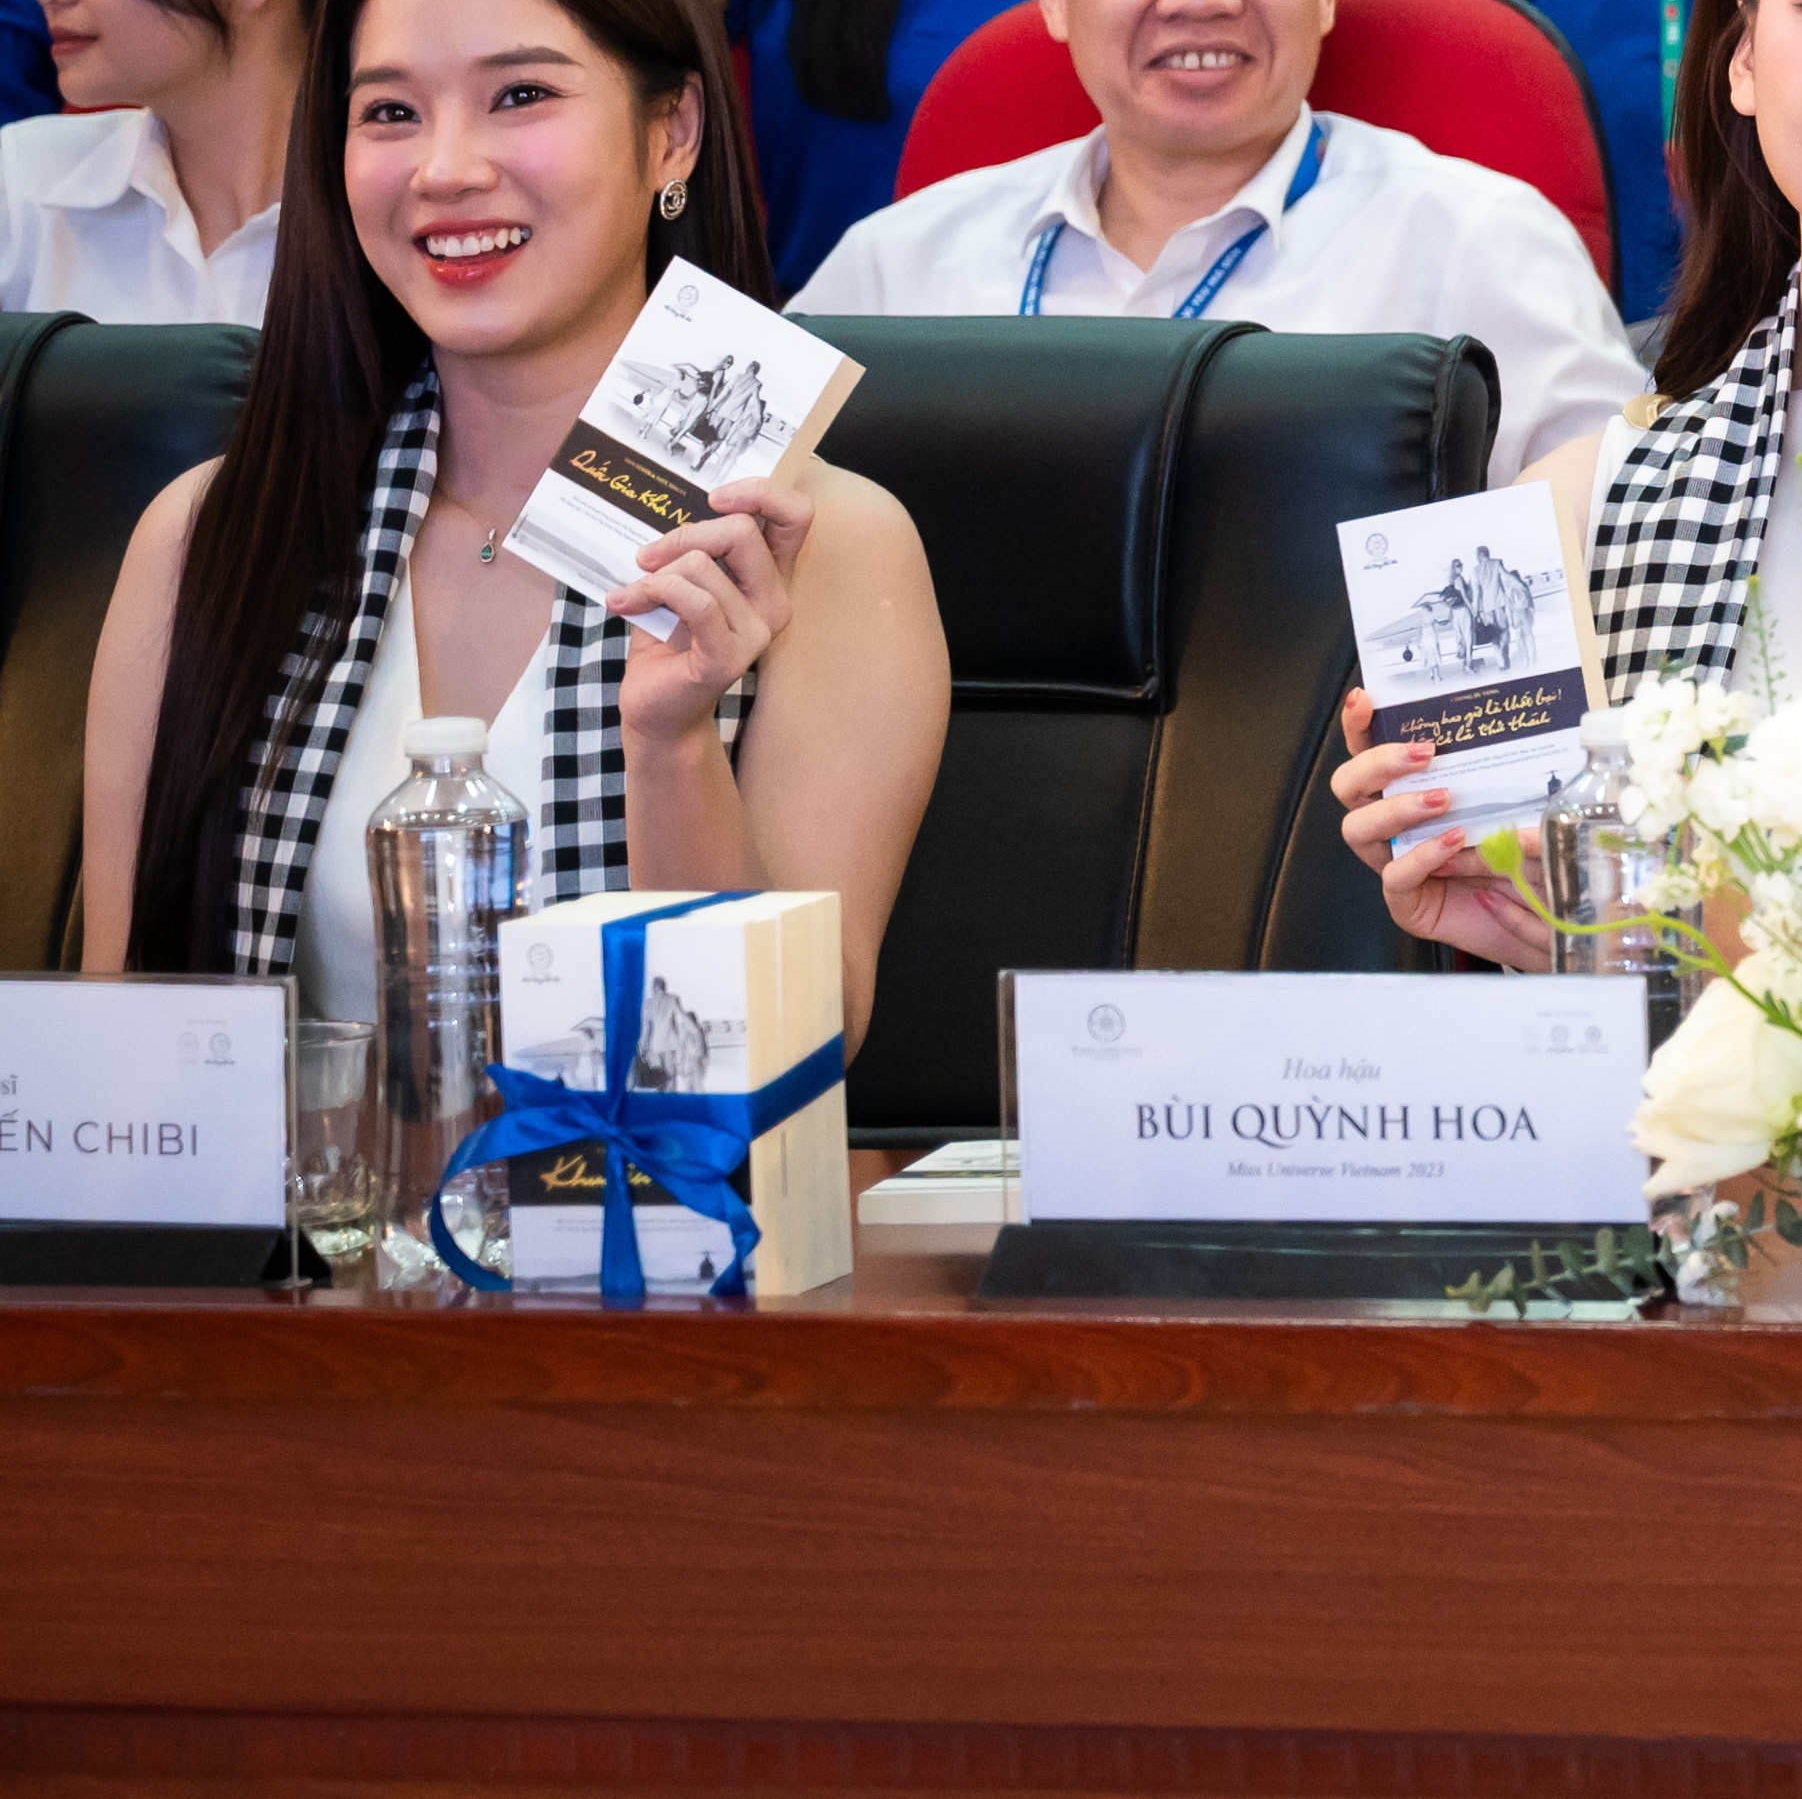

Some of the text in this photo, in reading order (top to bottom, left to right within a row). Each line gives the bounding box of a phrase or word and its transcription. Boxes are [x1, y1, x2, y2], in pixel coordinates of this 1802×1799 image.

[610, 474, 637, 499] Gia
[1401, 718, 1440, 737] Không
[1441, 710, 1462, 724] bao
[1485, 699, 1502, 715] là
[1283, 1058, 1382, 1084] Hoa hậu
[73, 1121, 197, 1155] CHIBI
[1136, 1094, 1539, 1149] BÙI QUỲNH HOA
